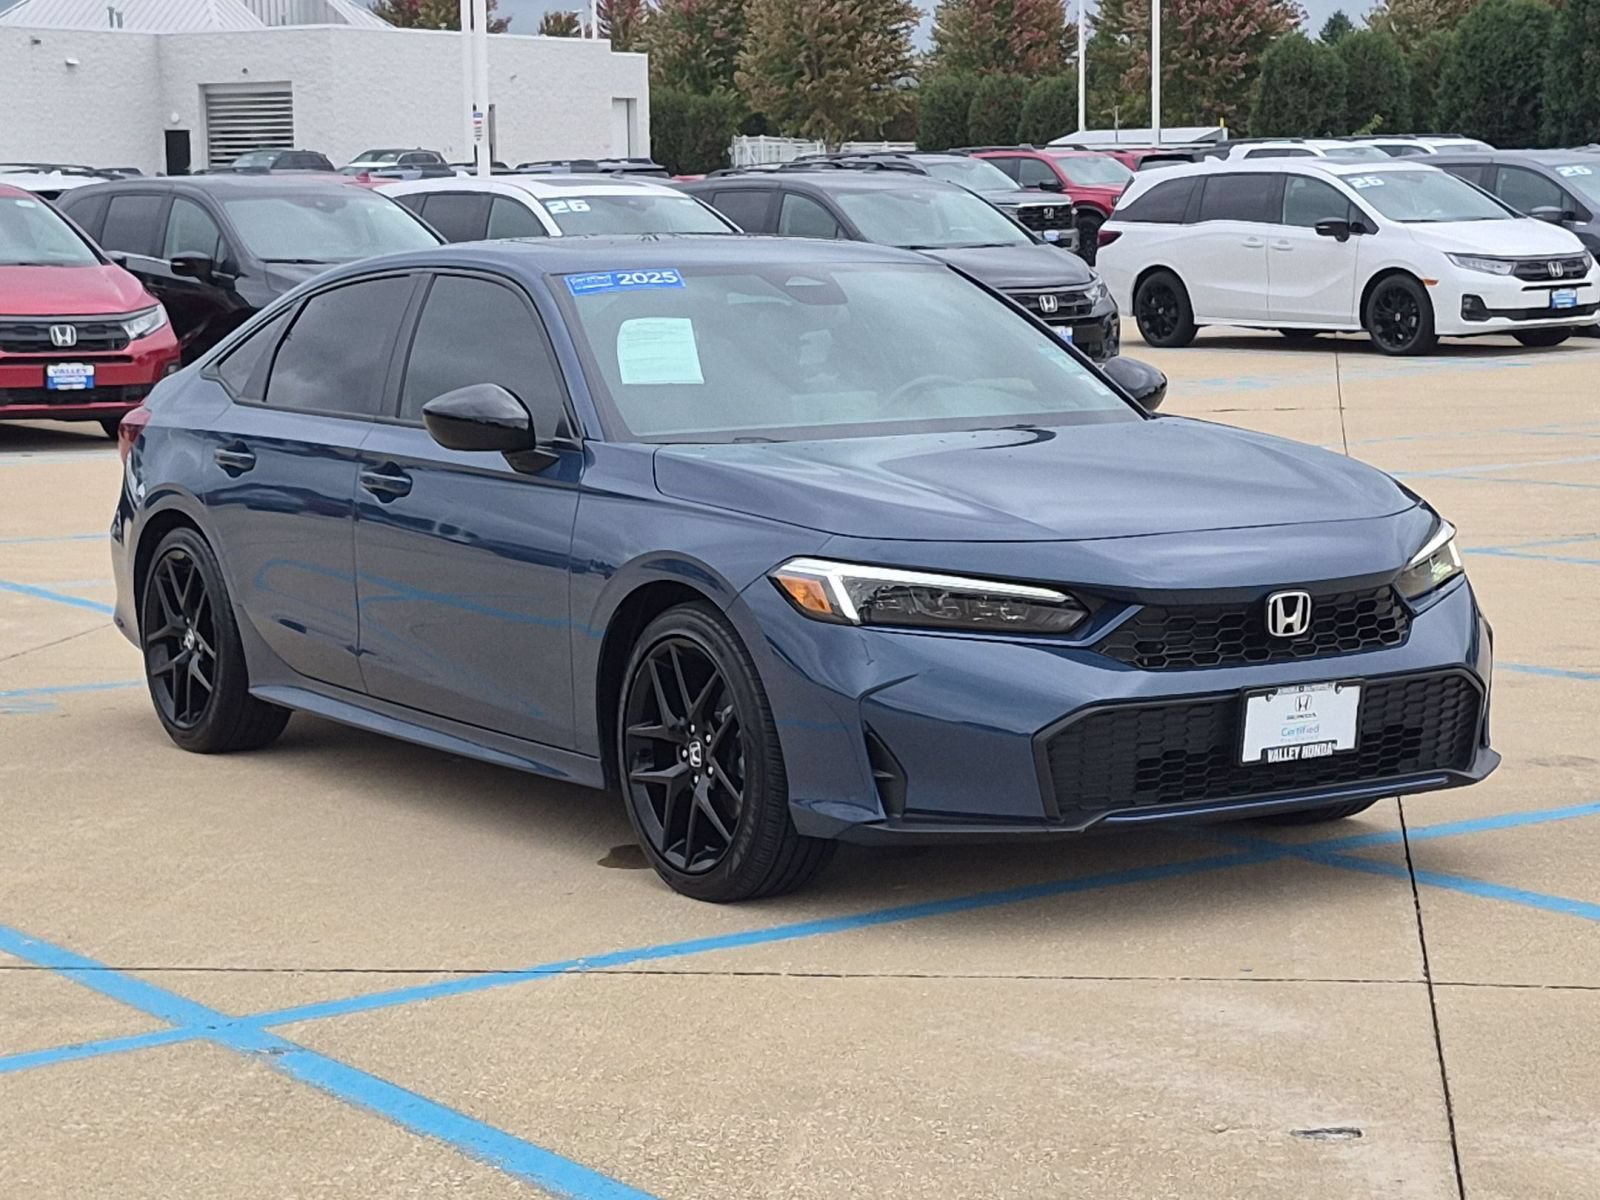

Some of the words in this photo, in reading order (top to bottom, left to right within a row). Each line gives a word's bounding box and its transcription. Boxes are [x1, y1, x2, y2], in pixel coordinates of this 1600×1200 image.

[1555, 165, 1592, 177] 26
[1347, 176, 1385, 188] 26
[545, 199, 592, 214] 26
[617, 271, 679, 285] 2025
[1280, 723, 1320, 738] Certified
[1266, 746, 1301, 764] VALLEY
[1301, 741, 1334, 760] HONDA
